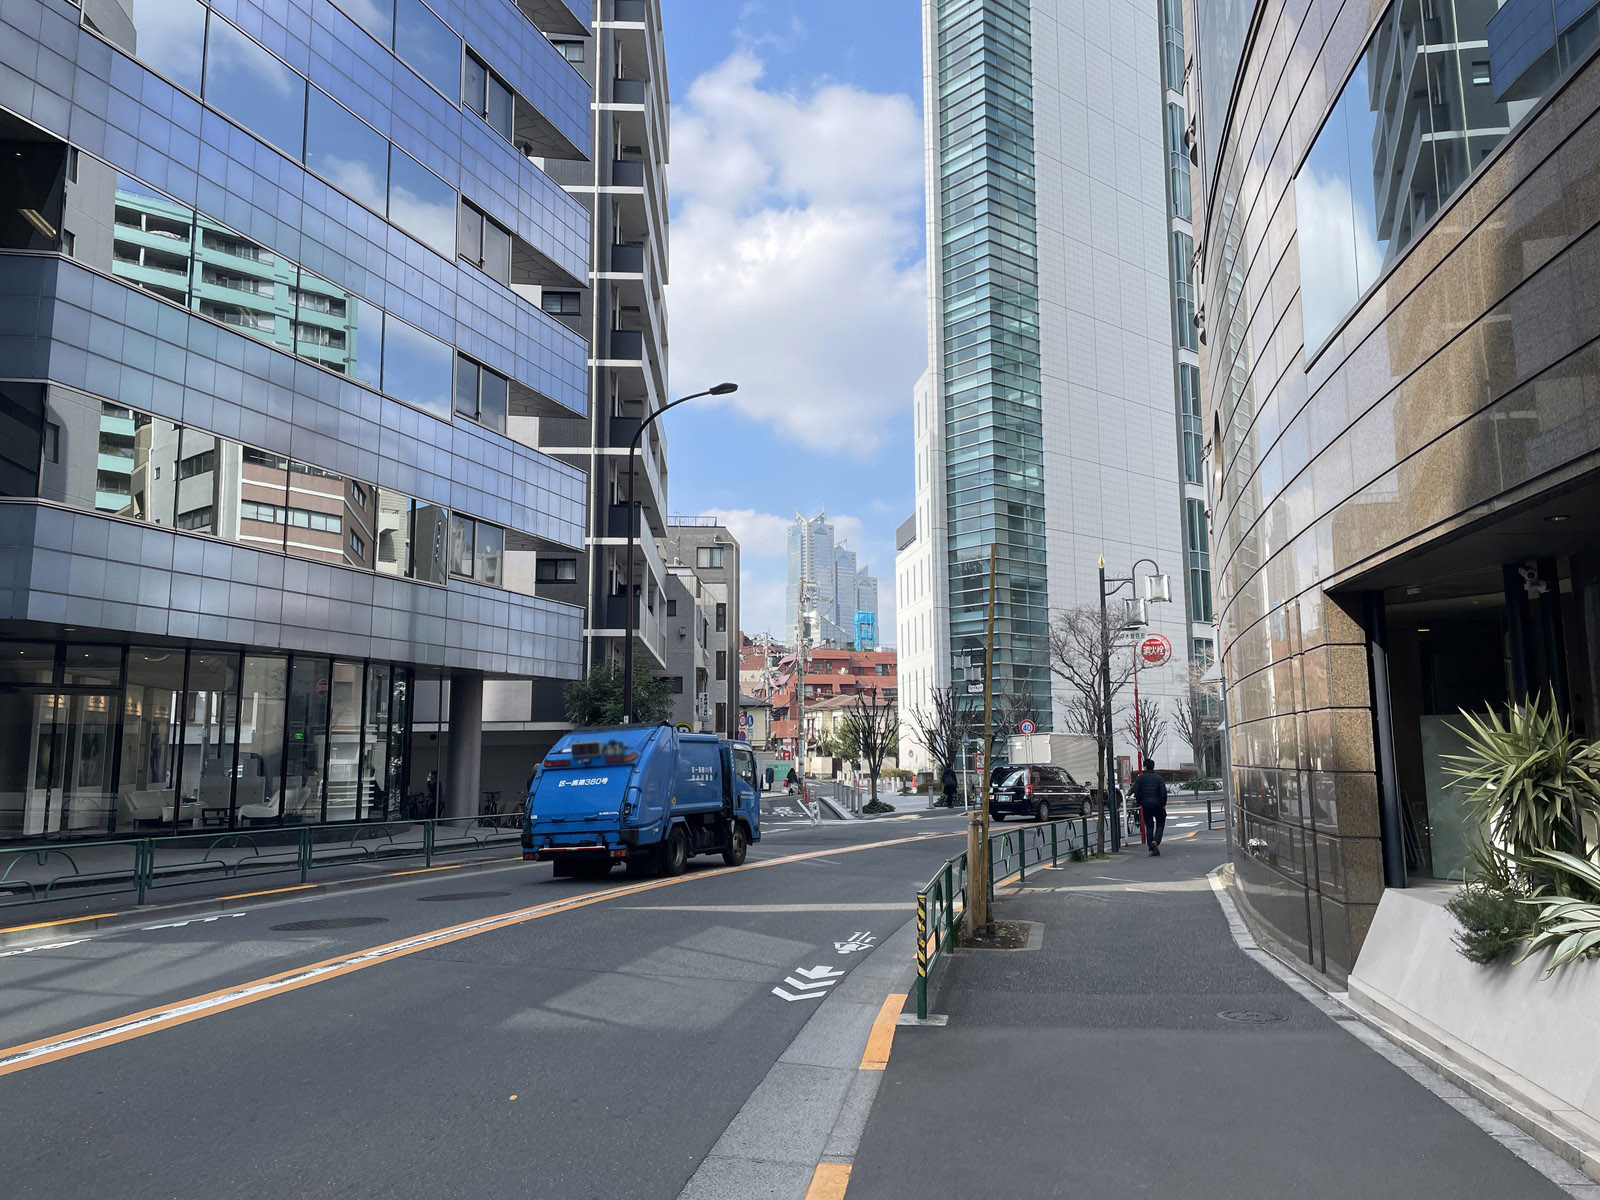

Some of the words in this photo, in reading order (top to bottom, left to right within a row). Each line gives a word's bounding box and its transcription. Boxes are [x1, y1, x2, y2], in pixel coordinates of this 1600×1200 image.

[1143, 645, 1165, 656] 消火栓
[1023, 724, 1032, 732] 40
